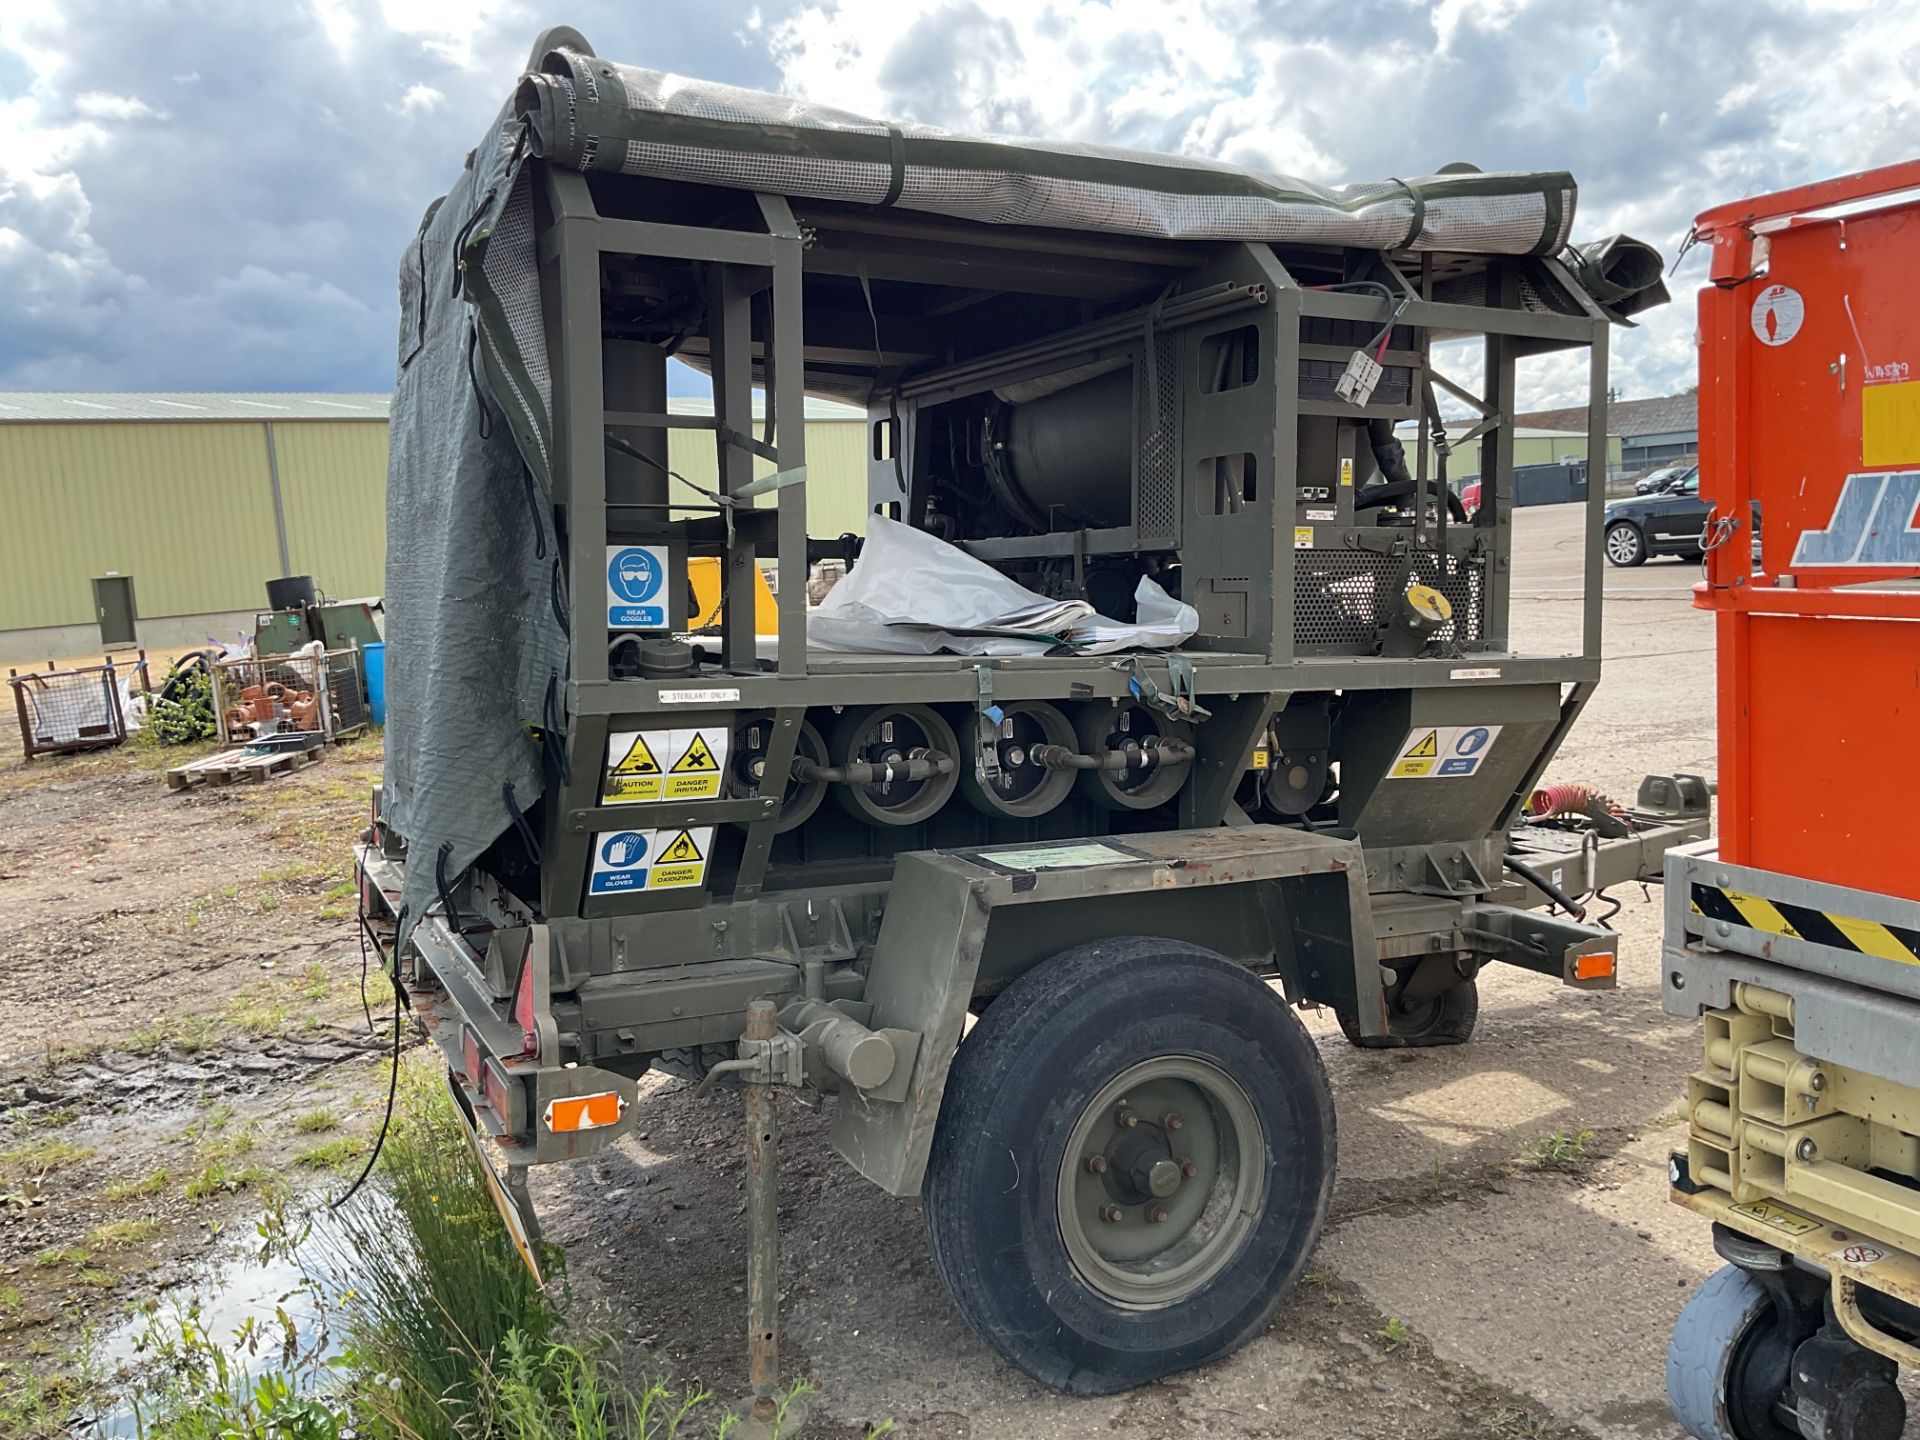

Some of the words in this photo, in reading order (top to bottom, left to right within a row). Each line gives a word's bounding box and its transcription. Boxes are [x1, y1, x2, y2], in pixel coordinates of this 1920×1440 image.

[672, 692, 706, 701] STERILANT
[710, 691, 726, 700] ONLY
[622, 780, 653, 788] AUTION
[676, 779, 708, 787] DANGER
[661, 869, 693, 877] DANGER
[605, 879, 633, 887] GLOVES
[657, 875, 695, 883] OXIDIZING
